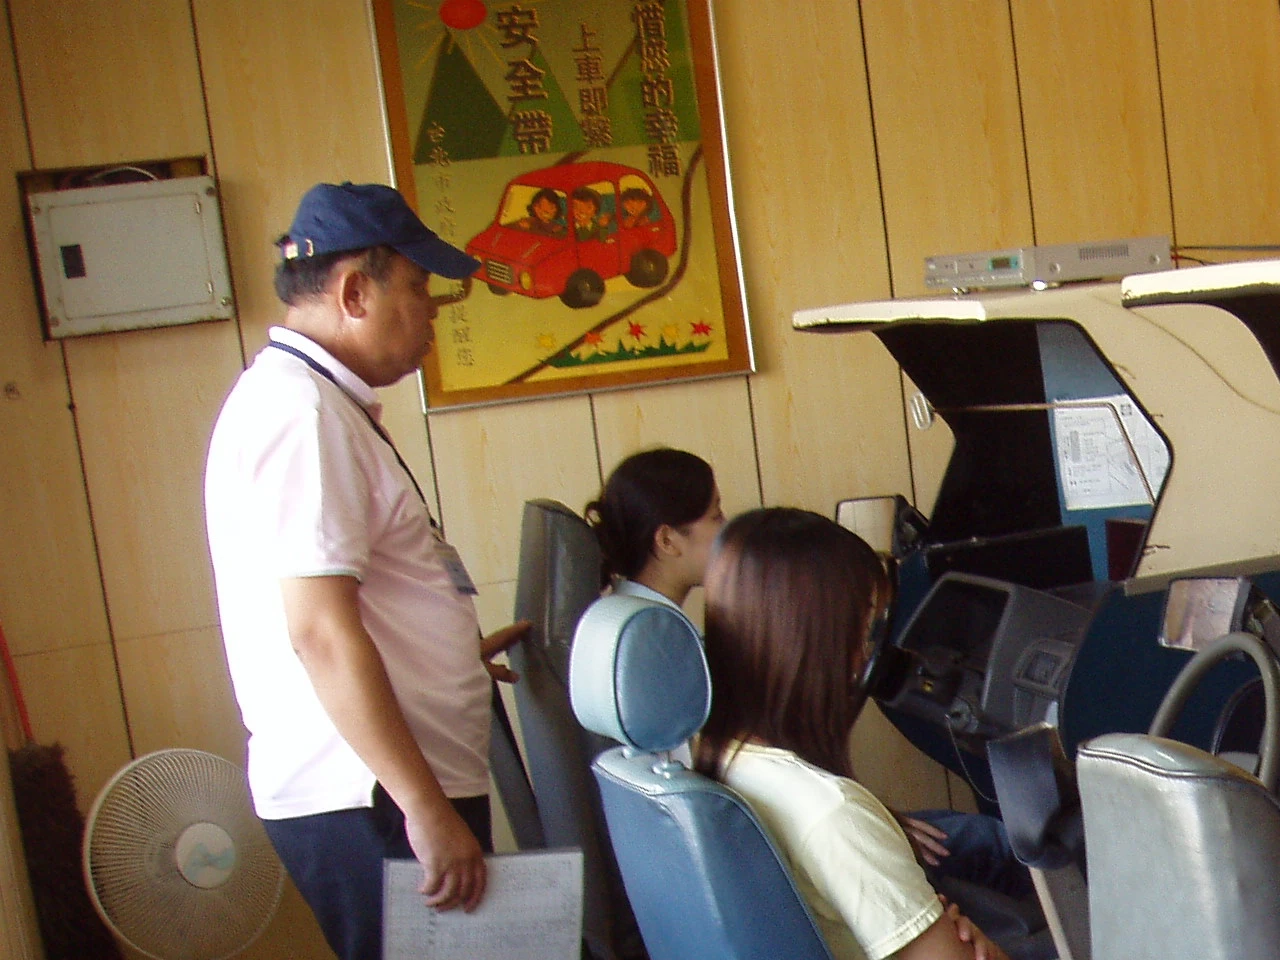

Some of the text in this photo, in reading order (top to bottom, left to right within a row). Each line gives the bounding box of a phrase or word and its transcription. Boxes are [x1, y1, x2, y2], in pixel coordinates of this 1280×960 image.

[496, 5, 552, 154] 安全帶
[572, 22, 612, 147] 上車即繫
